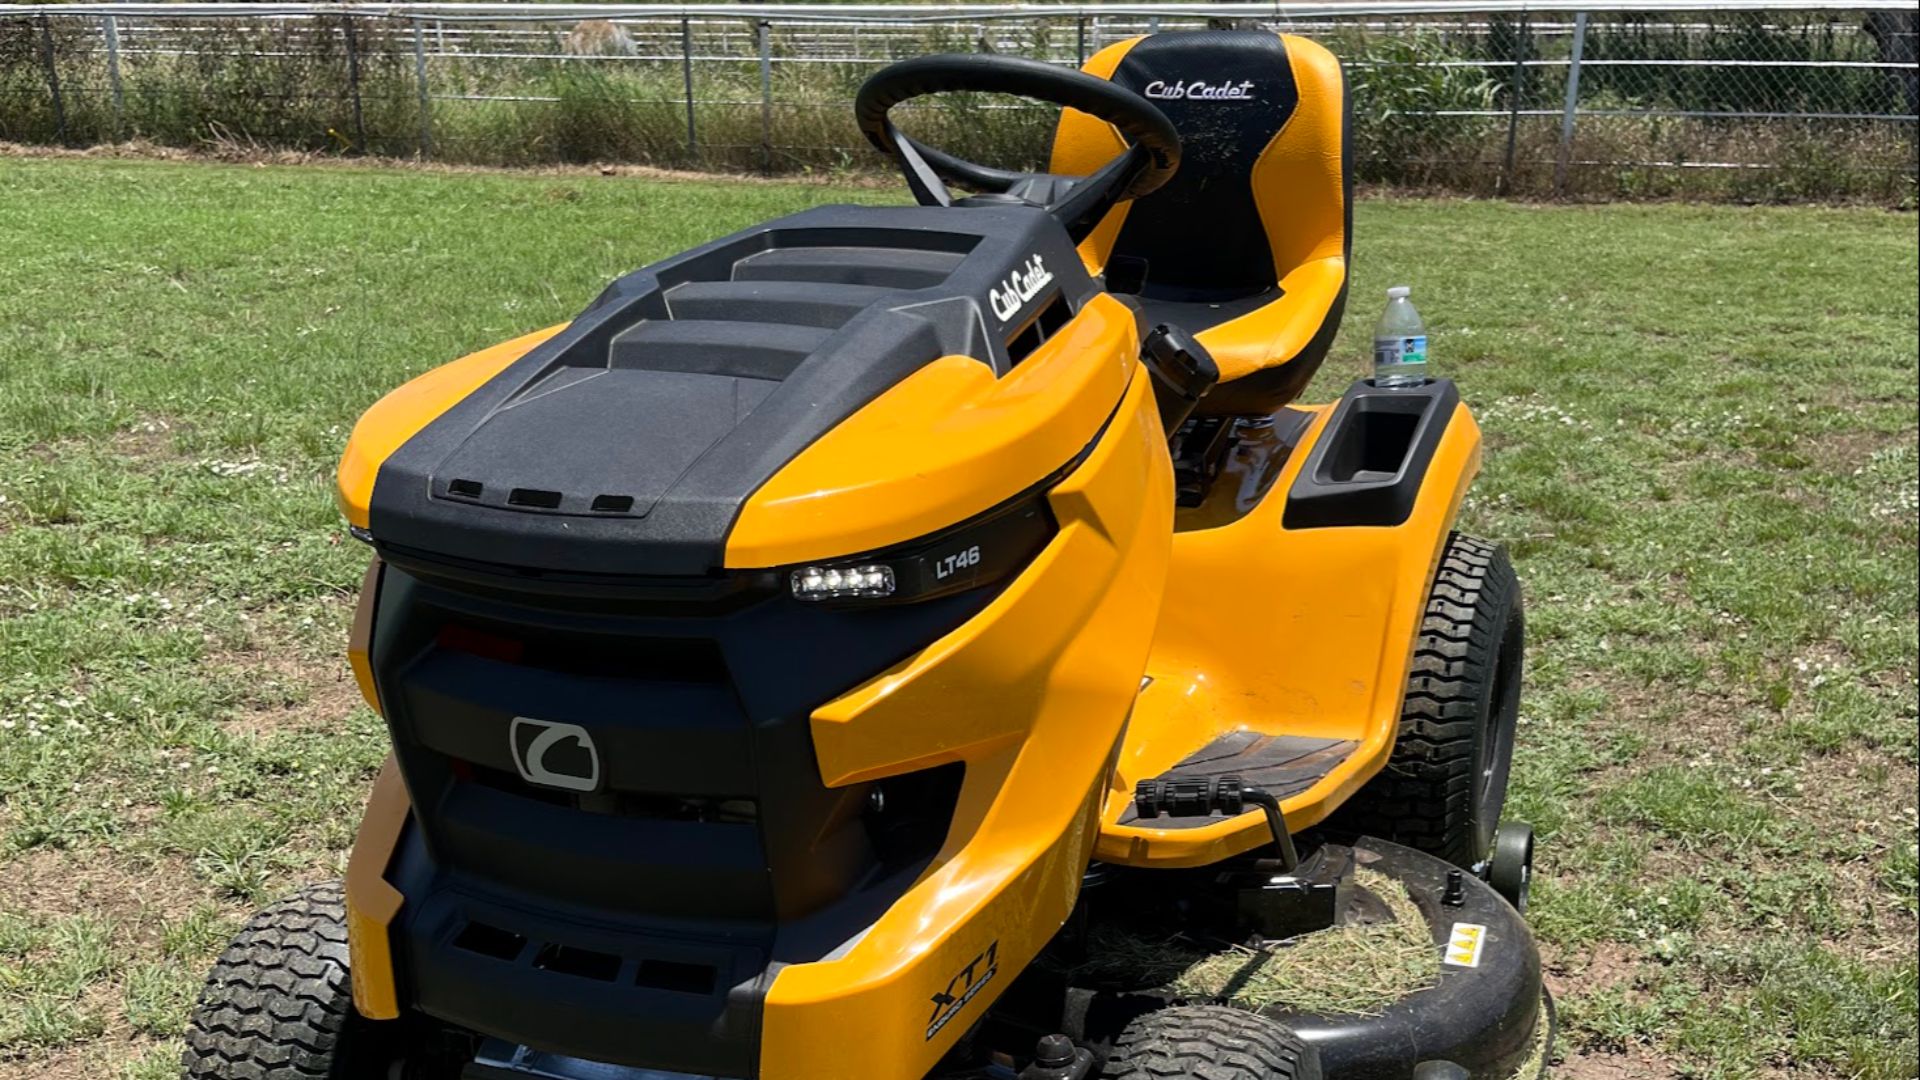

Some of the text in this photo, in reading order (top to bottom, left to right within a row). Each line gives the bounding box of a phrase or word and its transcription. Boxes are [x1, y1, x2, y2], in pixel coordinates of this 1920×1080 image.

[1145, 80, 1254, 99] Cub Cadet
[989, 253, 1054, 322] Cub Cadet
[936, 545, 980, 579] LT46
[929, 940, 998, 1024] XT1
